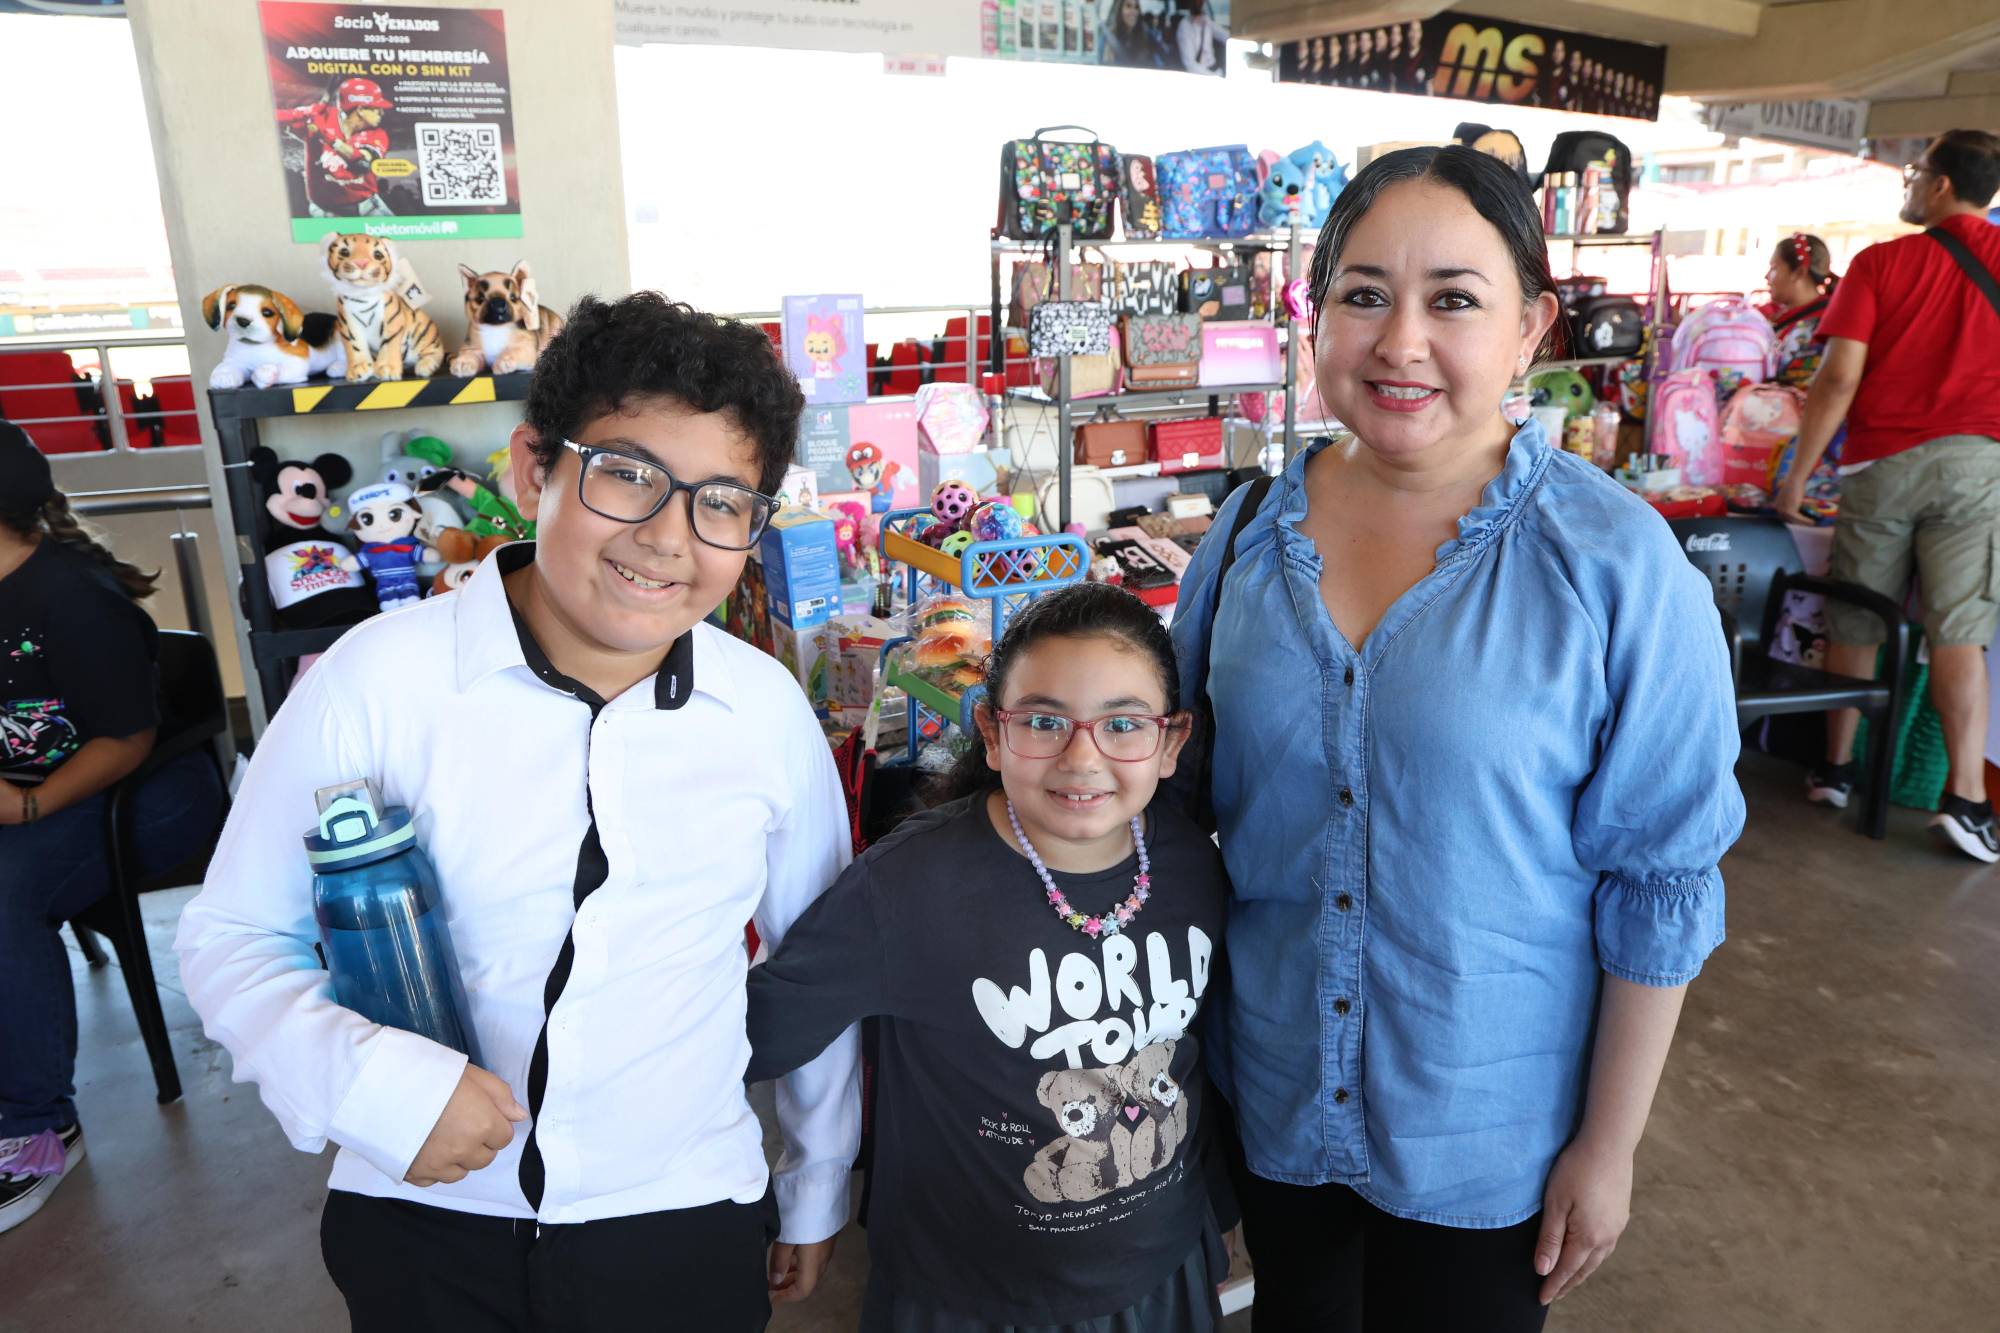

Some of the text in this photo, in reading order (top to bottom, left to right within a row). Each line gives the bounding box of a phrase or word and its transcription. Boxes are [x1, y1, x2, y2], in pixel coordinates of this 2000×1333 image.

[334, 15, 373, 29] Socio
[286, 46, 490, 64] ADQUIERE TU MEMBRESÍA
[307, 62, 472, 77] DIGITAL CON O SIN KIT
[1686, 532, 1731, 552] Coca-Cola
[972, 925, 1212, 1048] WORLD
[981, 1116, 1032, 1134] ROCK & ROLL
[985, 1130, 1024, 1145] ATTITUDE
[1062, 1209, 1083, 1219] NEW
[1084, 1204, 1108, 1217] YORK
